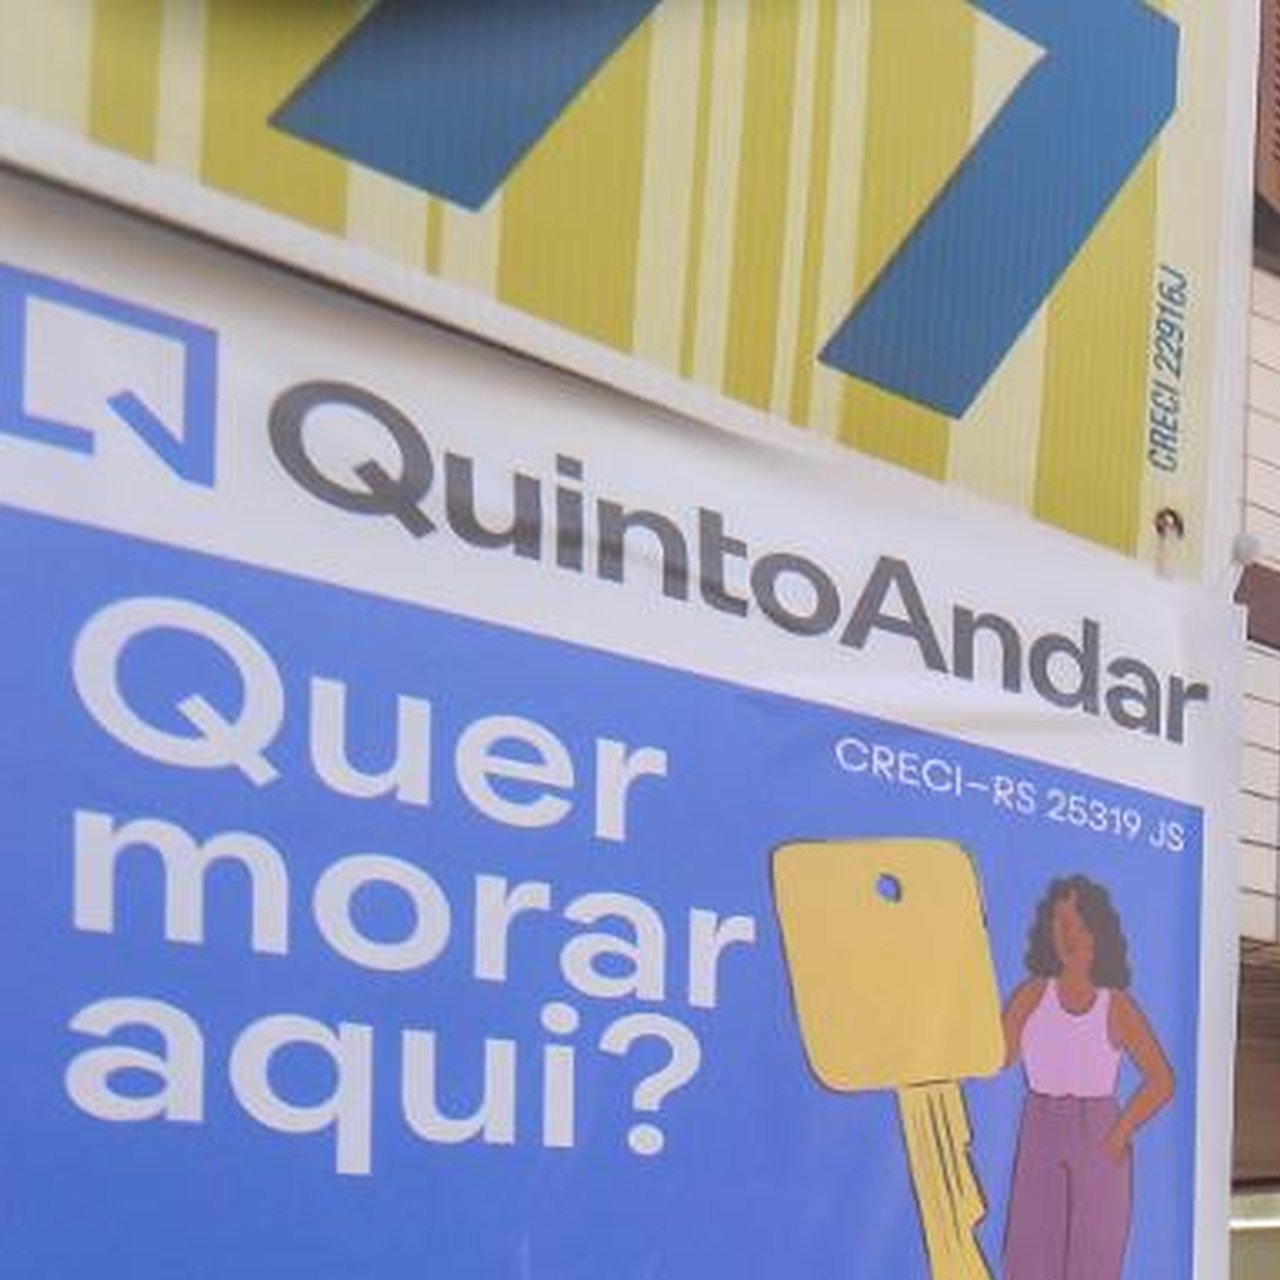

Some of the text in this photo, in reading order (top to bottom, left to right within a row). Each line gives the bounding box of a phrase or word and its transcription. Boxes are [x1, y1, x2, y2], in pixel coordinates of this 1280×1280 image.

[1148, 264, 1188, 473] CRECI 22916J
[266, 379, 1210, 744] QuintoAndar
[72, 596, 668, 842] Quer
[1048, 789, 1142, 837] 25319
[1149, 820, 1186, 852] JS
[73, 809, 756, 1009] morar
[64, 995, 702, 1177] aqui?
